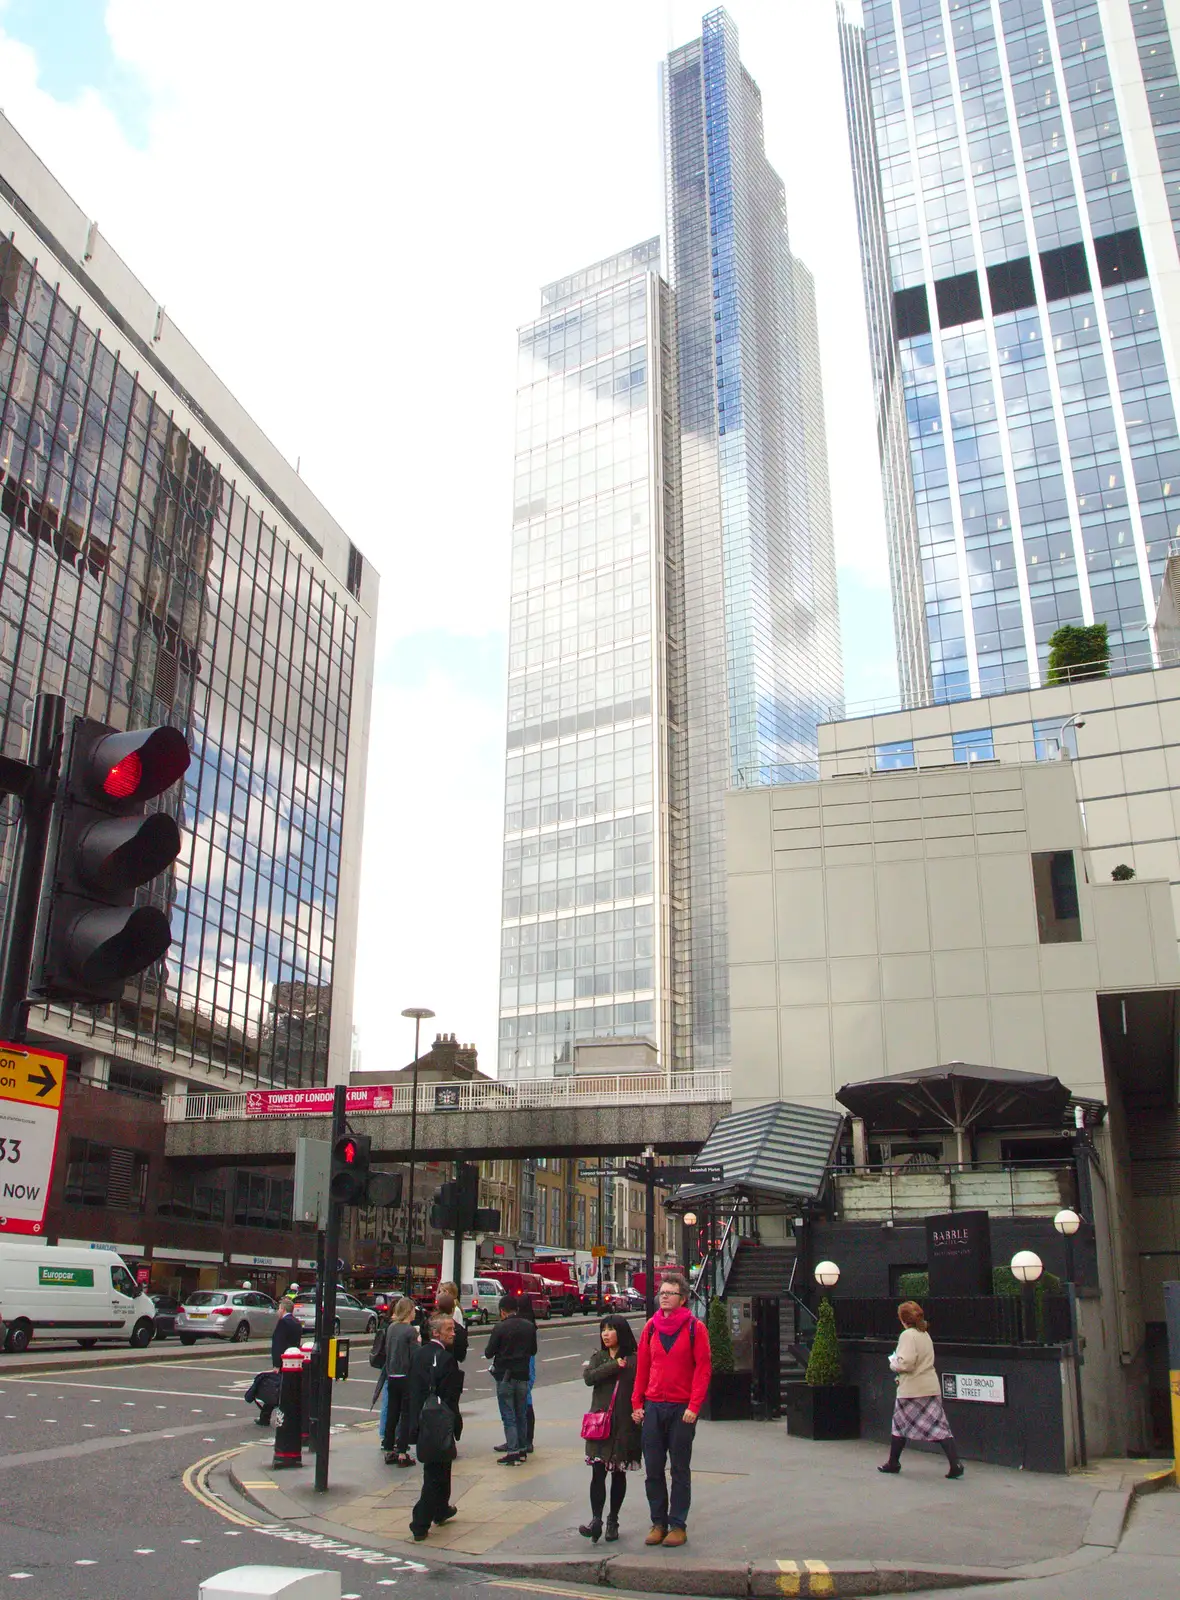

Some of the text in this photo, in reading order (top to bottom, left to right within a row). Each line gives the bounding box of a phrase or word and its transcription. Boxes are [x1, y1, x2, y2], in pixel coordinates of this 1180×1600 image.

[268, 1093, 294, 1104] TOWER
[295, 1093, 304, 1103] OF
[305, 1092, 335, 1103] LONDON
[351, 1091, 367, 1100] RUN
[3, 1183, 40, 1200] NOW
[932, 1229, 969, 1241] BABBLE
[42, 1269, 74, 1280] Europcar
[960, 1378, 995, 1388] OLD BROAD
[960, 1388, 981, 1397] STREET
